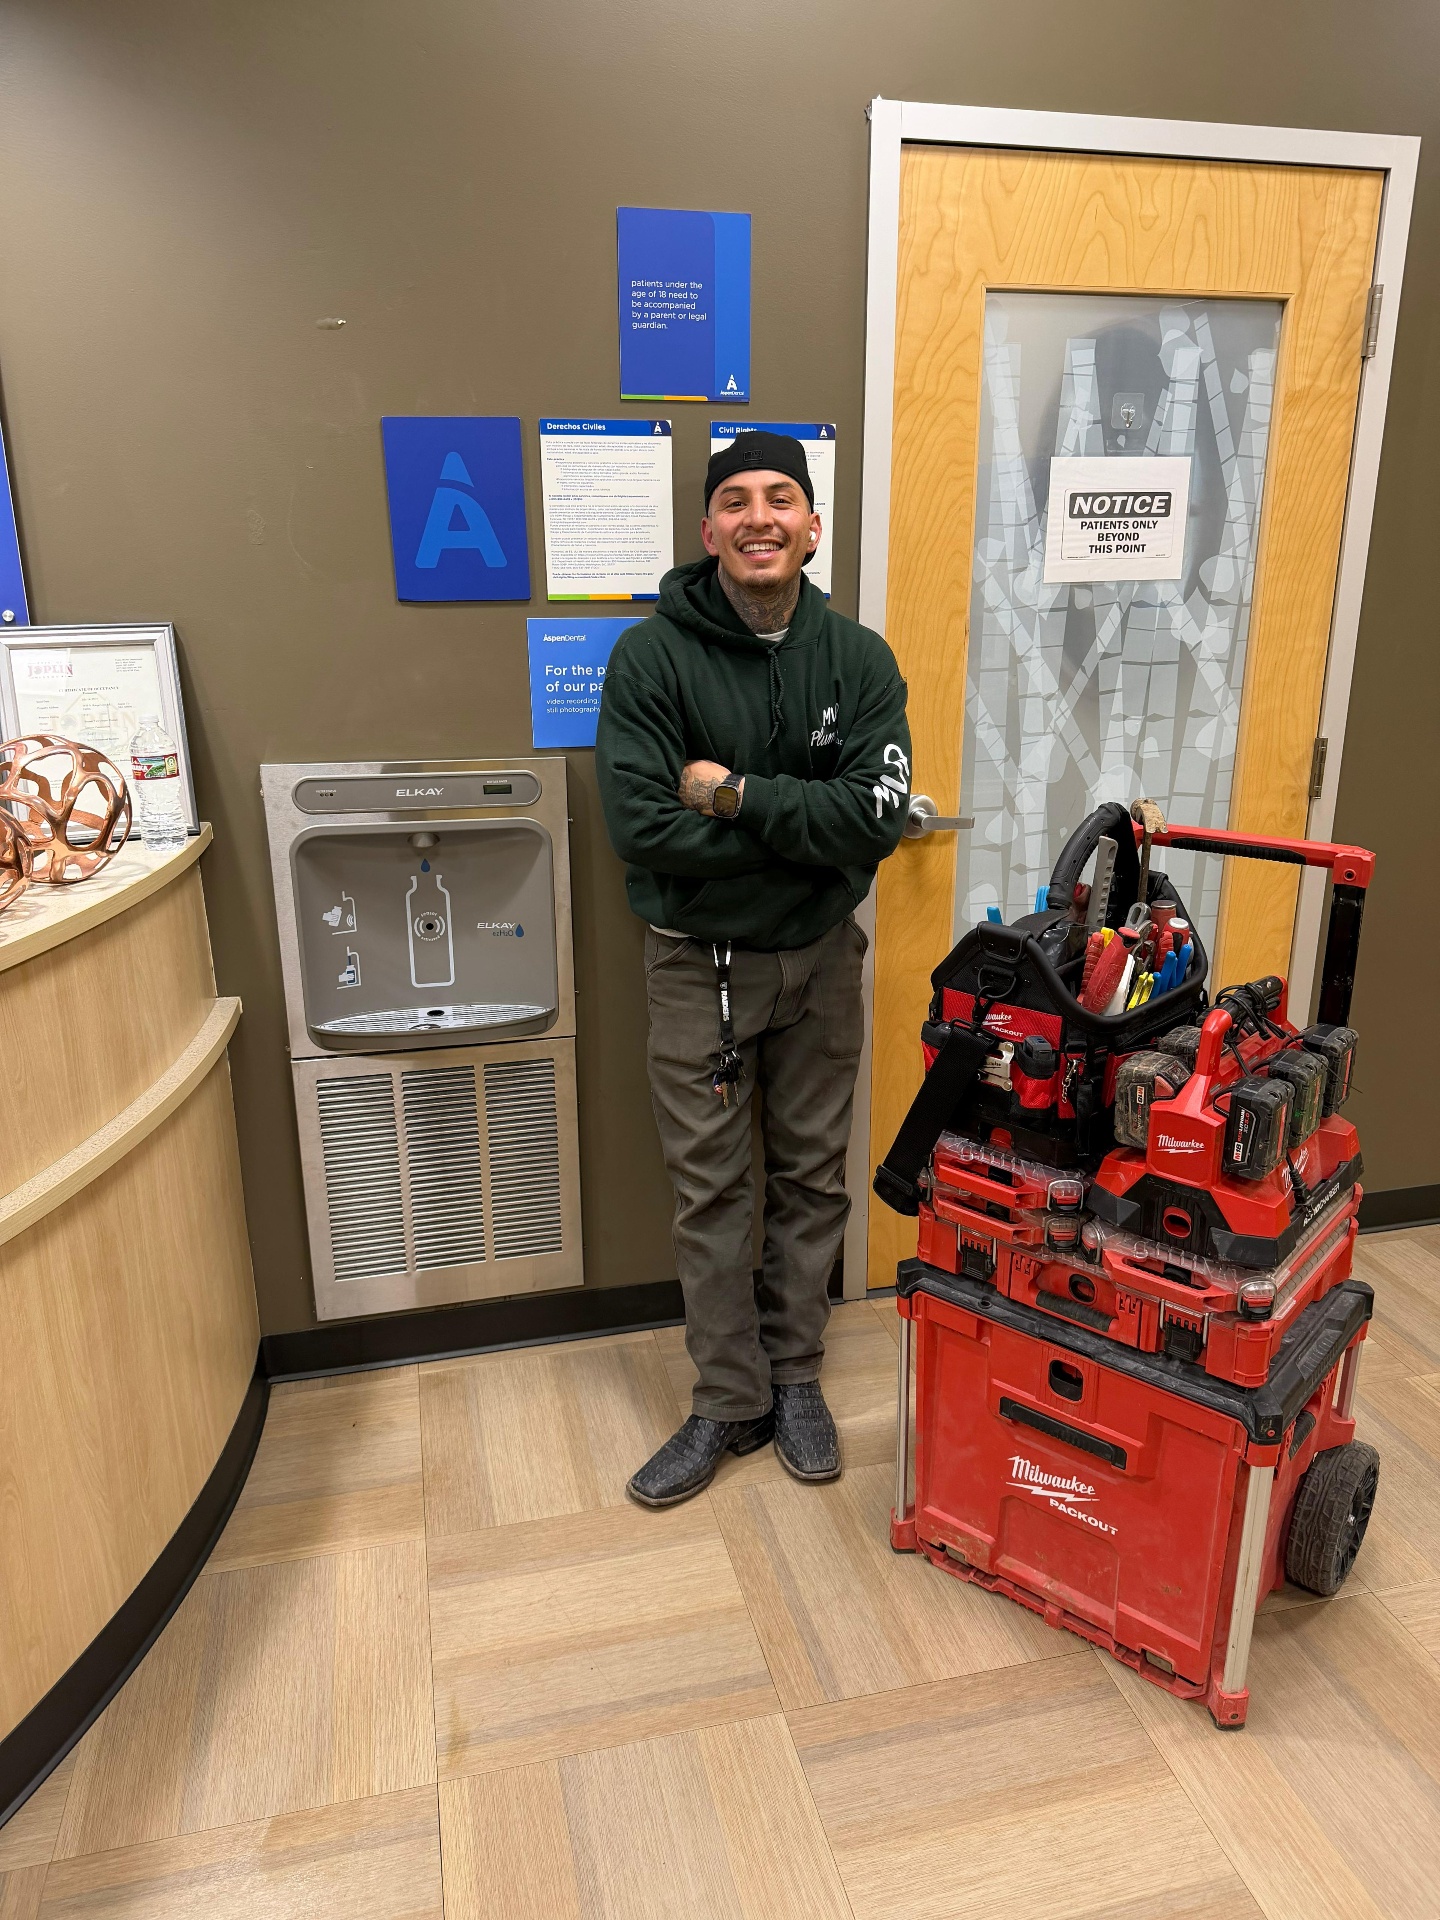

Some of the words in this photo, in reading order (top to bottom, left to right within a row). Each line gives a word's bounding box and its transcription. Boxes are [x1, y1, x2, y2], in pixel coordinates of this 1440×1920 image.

[631, 280, 663, 288] patients
[665, 281, 688, 289] under
[690, 282, 703, 290] the
[648, 290, 656, 298] of
[668, 291, 688, 299] need
[631, 300, 642, 308] be
[644, 301, 696, 310] accompanied
[631, 311, 642, 319] by
[650, 312, 676, 320] parent
[688, 313, 707, 321] legal
[546, 422, 581, 430] Derechos
[582, 423, 606, 431] Civiles
[1072, 495, 1169, 515] NOTICE
[1080, 520, 1129, 530] PATIENTS
[1132, 520, 1159, 529] ONLY
[1097, 532, 1140, 541] BEYOND
[1088, 544, 1113, 554] THIS
[1115, 543, 1147, 553] POINT
[545, 665, 567, 675] For
[572, 665, 593, 675] the
[546, 681, 559, 692] of
[564, 682, 585, 692] our
[396, 787, 444, 797] ELKAY
[991, 1025, 1023, 1037] PACKOUT
[1156, 1133, 1205, 1149] Milwaukee
[1234, 1143, 1242, 1160] M18
[1007, 1455, 1096, 1495] Milwaukee
[1049, 1498, 1118, 1535] PACKOUT
